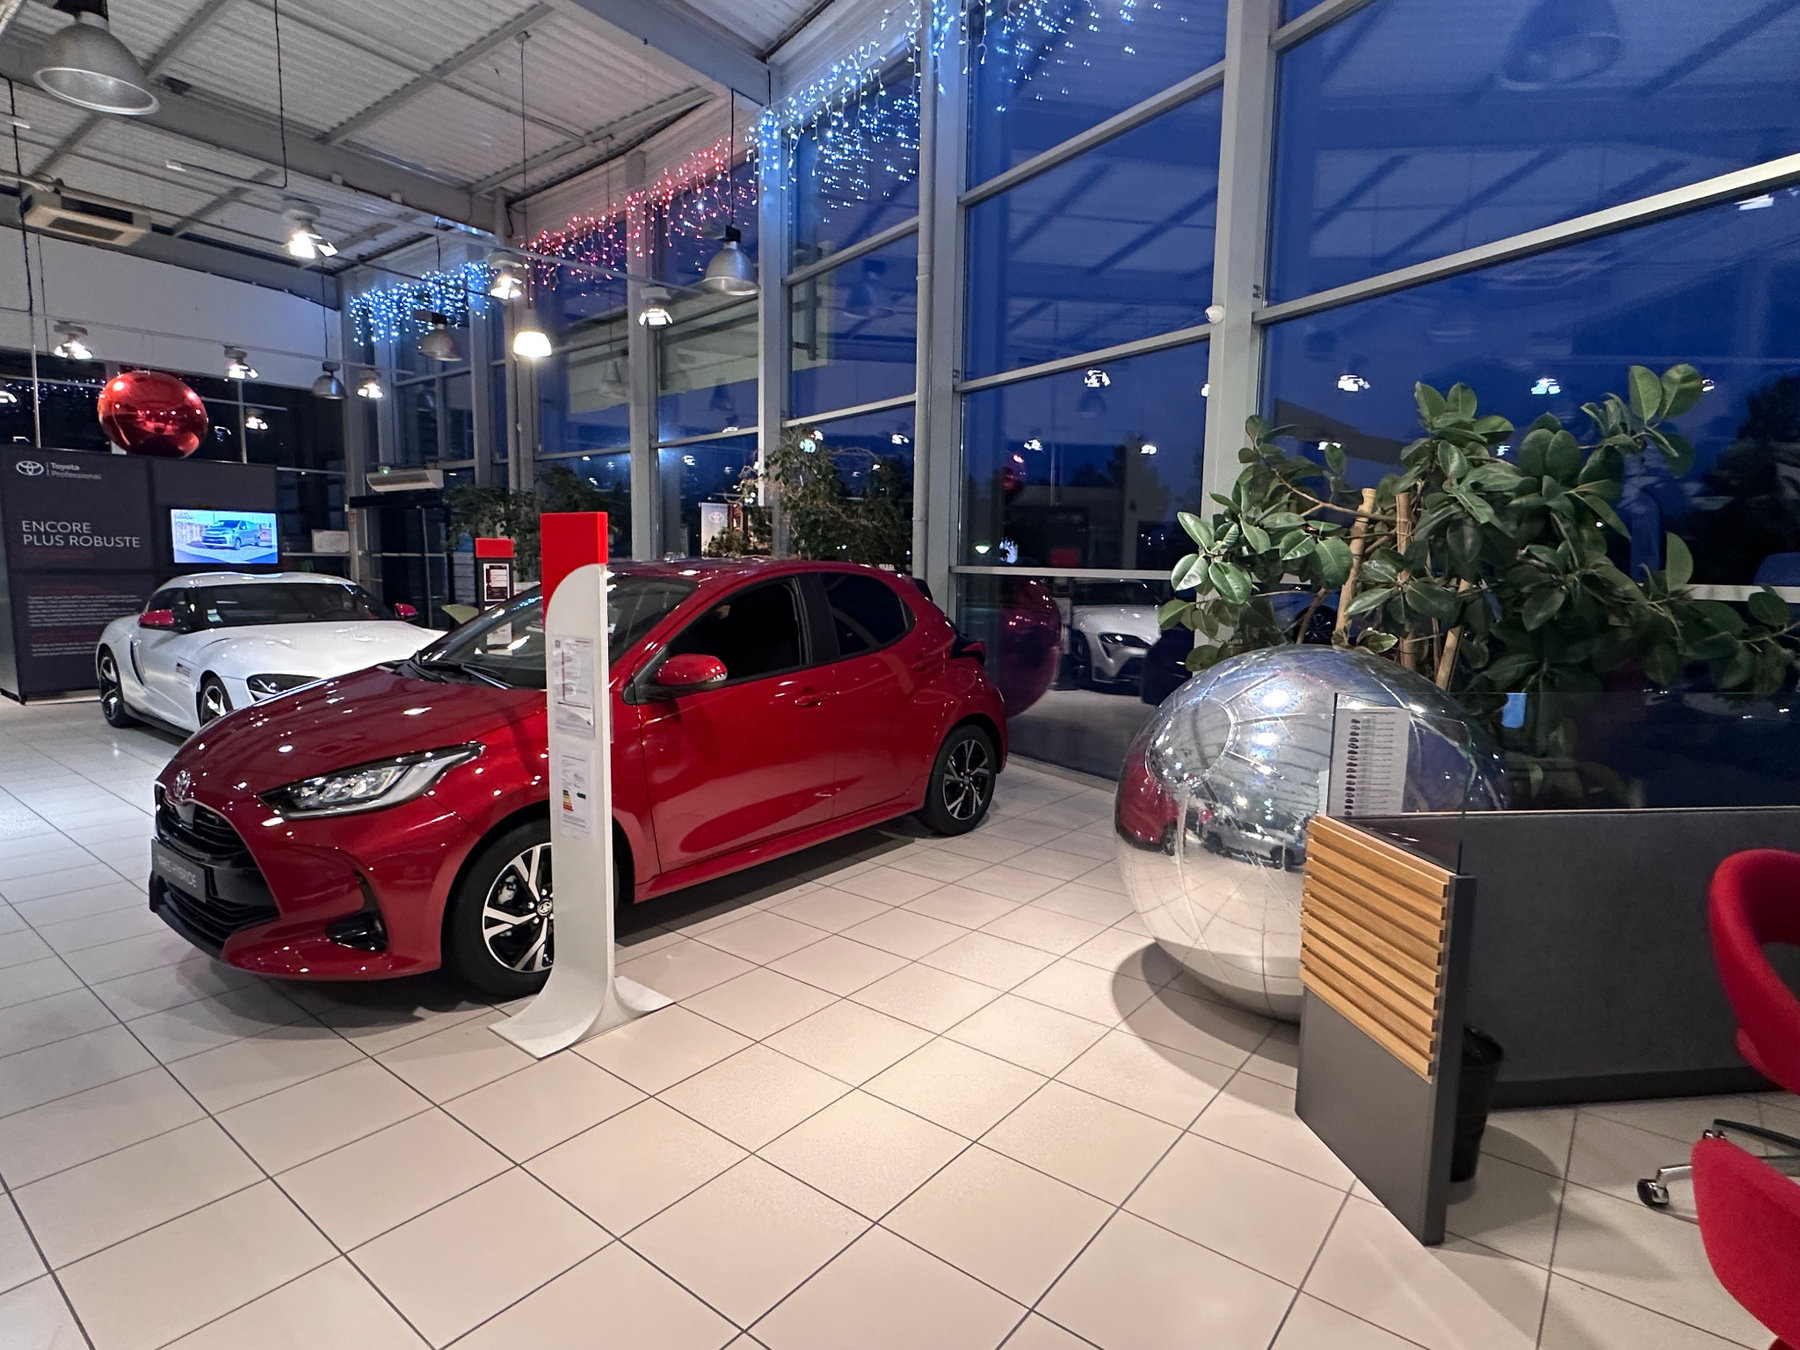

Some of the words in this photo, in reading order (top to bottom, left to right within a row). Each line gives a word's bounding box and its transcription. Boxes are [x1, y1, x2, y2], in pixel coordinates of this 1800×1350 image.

[50, 462, 80, 472] Toyota
[51, 470, 102, 480] Professional
[22, 520, 91, 534] ENCORE
[23, 534, 65, 546] PLUS
[69, 535, 141, 548] ROBUSTE
